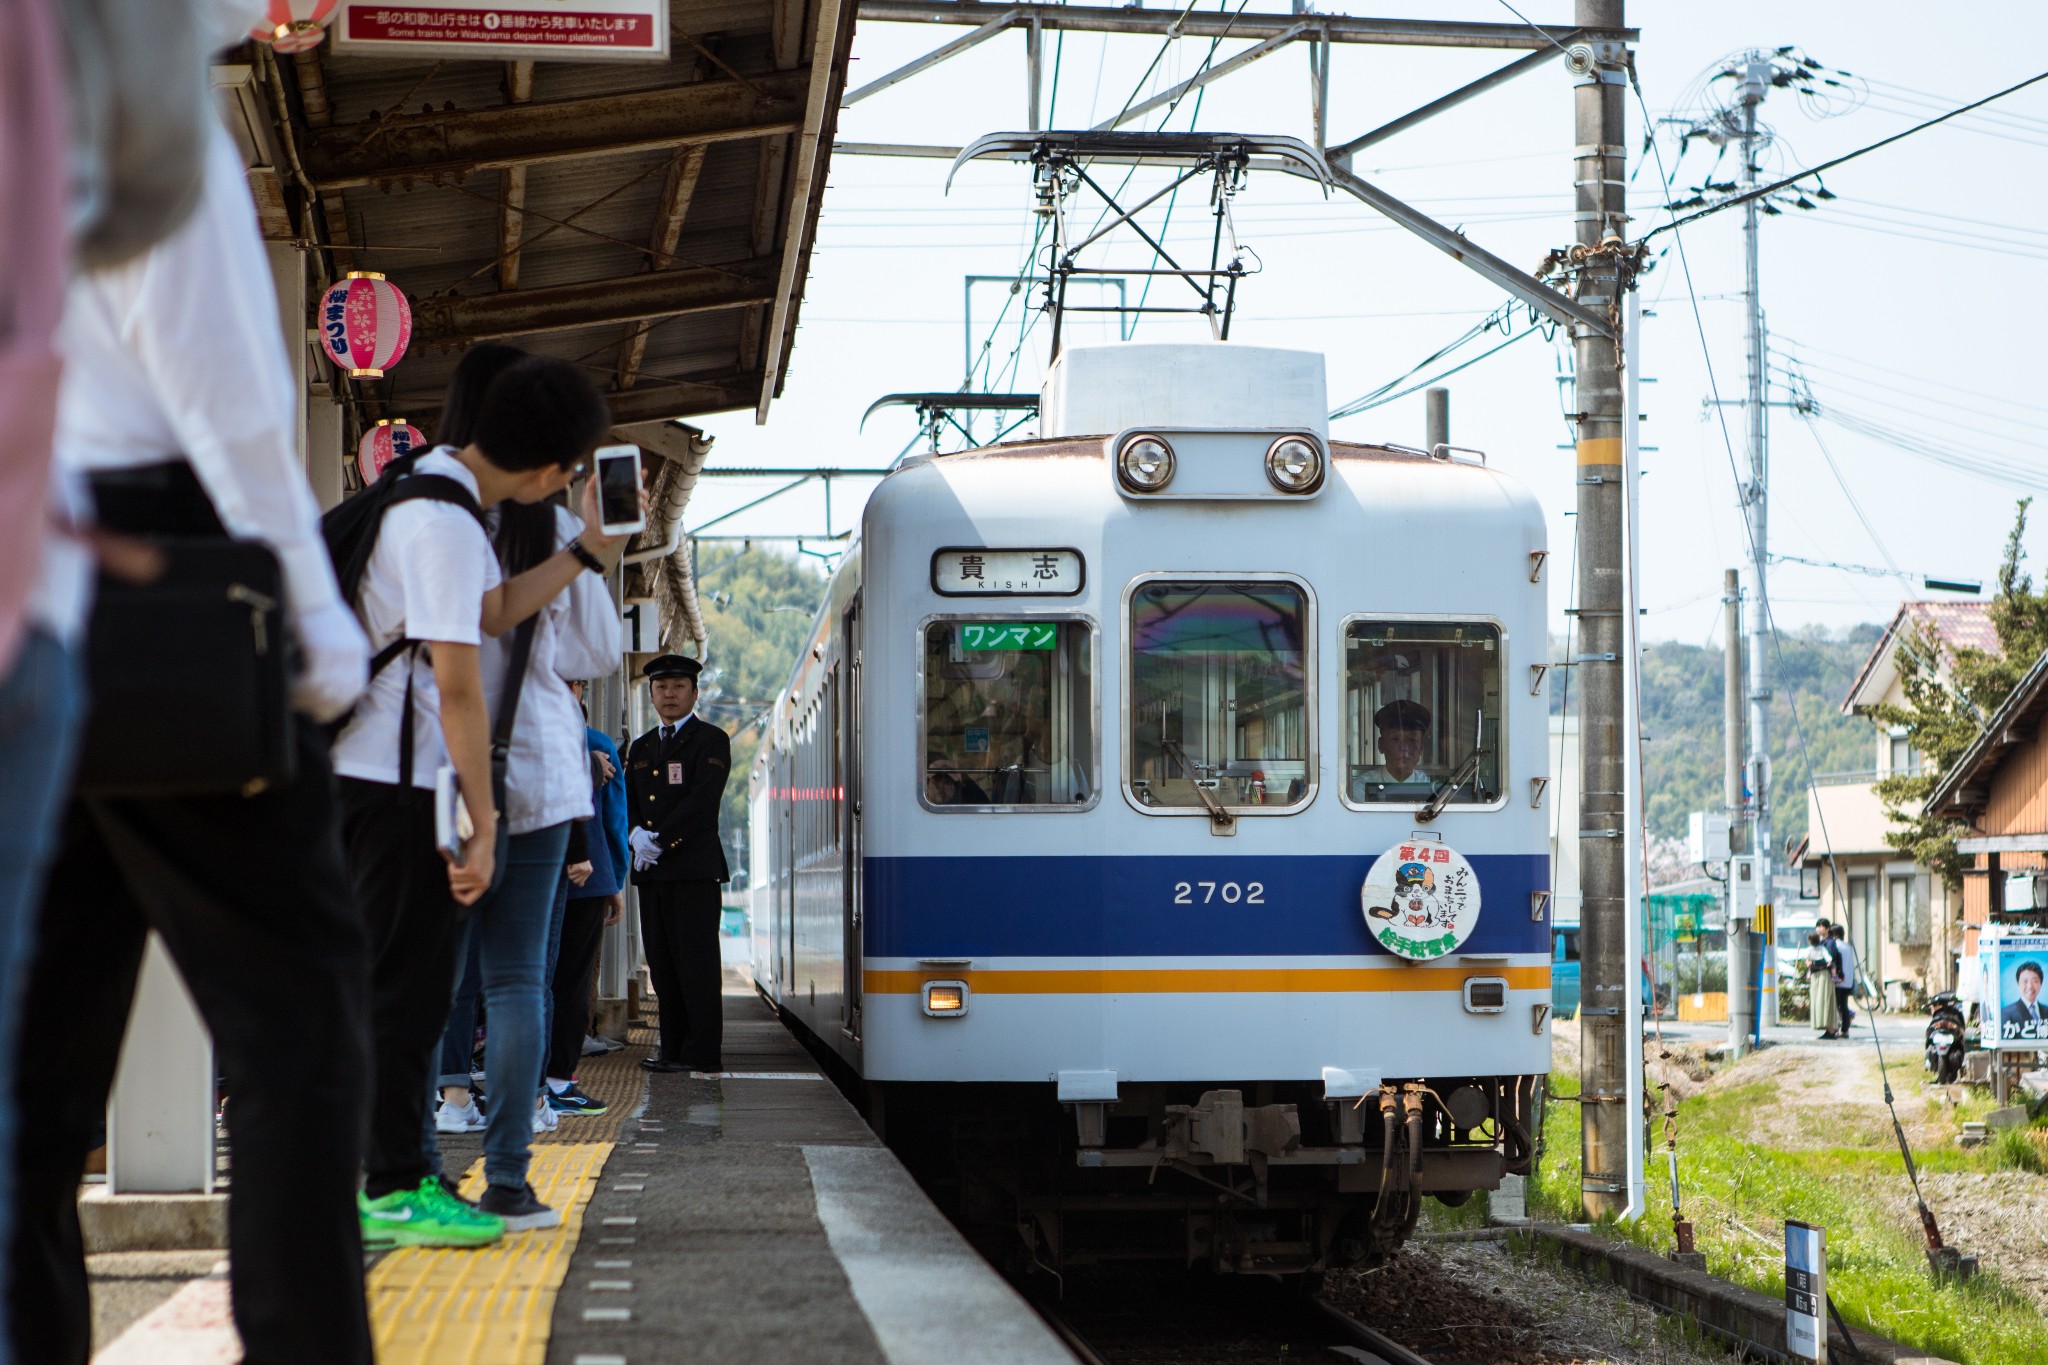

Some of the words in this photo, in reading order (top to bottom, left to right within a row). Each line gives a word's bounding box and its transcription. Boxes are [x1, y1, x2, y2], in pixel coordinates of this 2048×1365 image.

[388, 28, 415, 37] Some
[417, 29, 443, 38] trains
[446, 29, 459, 38] for
[461, 30, 511, 41] Wakayama
[513, 31, 543, 42] depart
[545, 32, 567, 41] from
[568, 33, 608, 43] platform
[959, 555, 1059, 580] 貴志
[978, 581, 1042, 589] KISHI
[623, 604, 641, 651] 1
[964, 625, 1054, 648] ワンマン
[1399, 846, 1450, 863] 第4回
[1175, 882, 1265, 904] 2702
